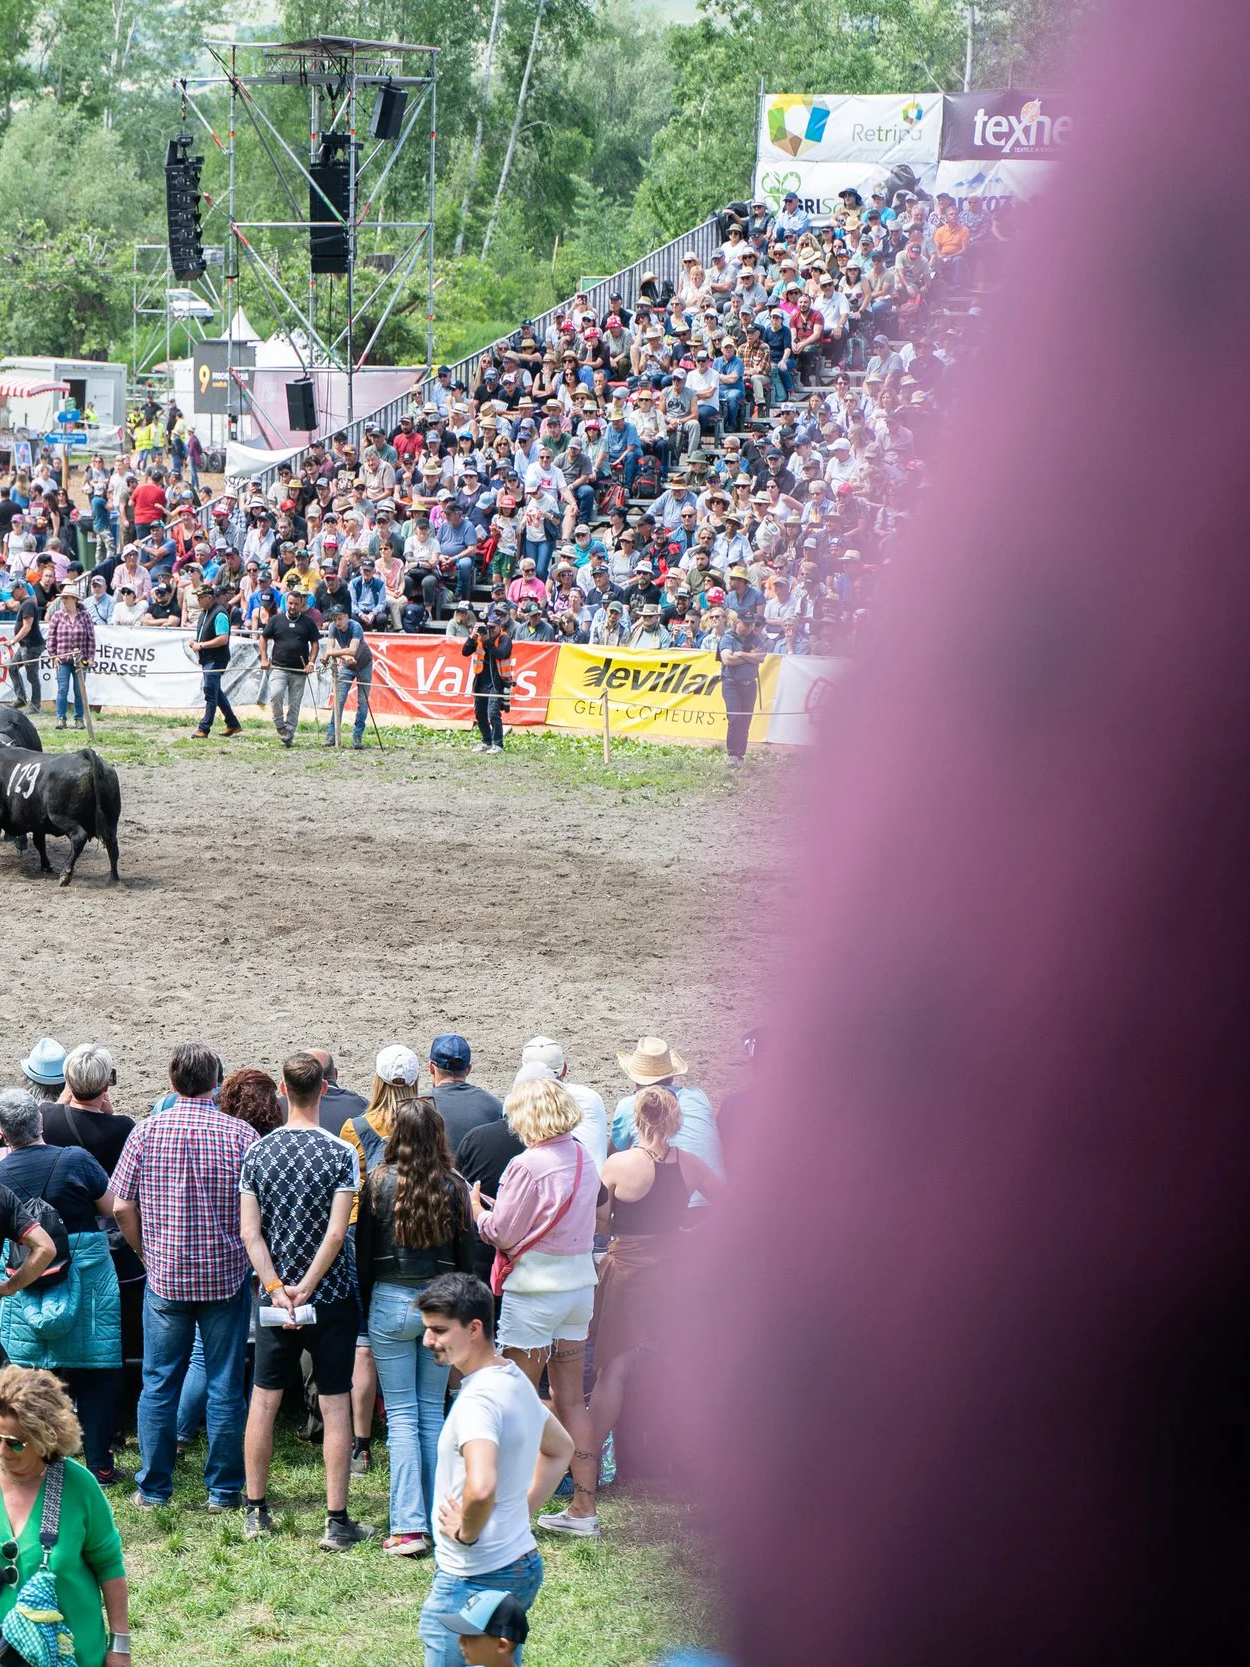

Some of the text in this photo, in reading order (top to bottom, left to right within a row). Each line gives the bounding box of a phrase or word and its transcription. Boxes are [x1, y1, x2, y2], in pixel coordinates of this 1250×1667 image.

[852, 123, 923, 145] Retripa
[973, 108, 1074, 153] texne
[199, 365, 210, 393] 9
[582, 657, 722, 696] devillar
[625, 704, 716, 726] COPIEURS
